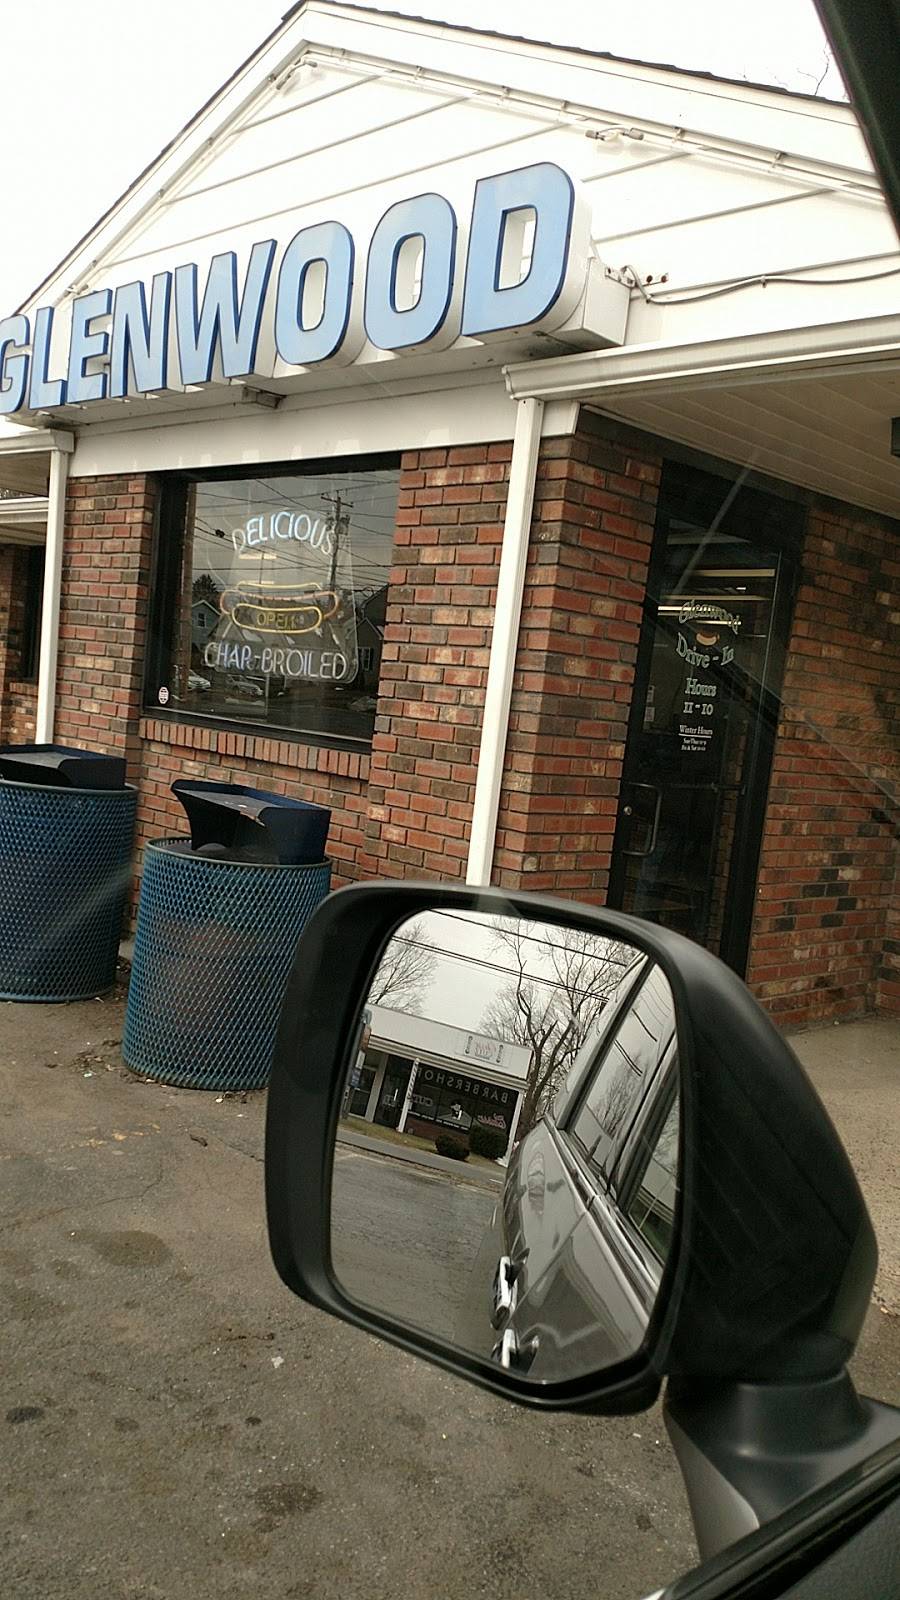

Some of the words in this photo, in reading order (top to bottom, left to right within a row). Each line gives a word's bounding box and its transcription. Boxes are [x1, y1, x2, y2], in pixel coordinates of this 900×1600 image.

[0, 162, 575, 414] GLENWOOD
[232, 511, 335, 555] DELICIOUS
[257, 611, 298, 629] OPEN
[204, 641, 347, 680] CHAR-BROILED
[685, 677, 716, 697] Hours
[679, 724, 697, 734] Winter
[697, 726, 713, 735] Hours
